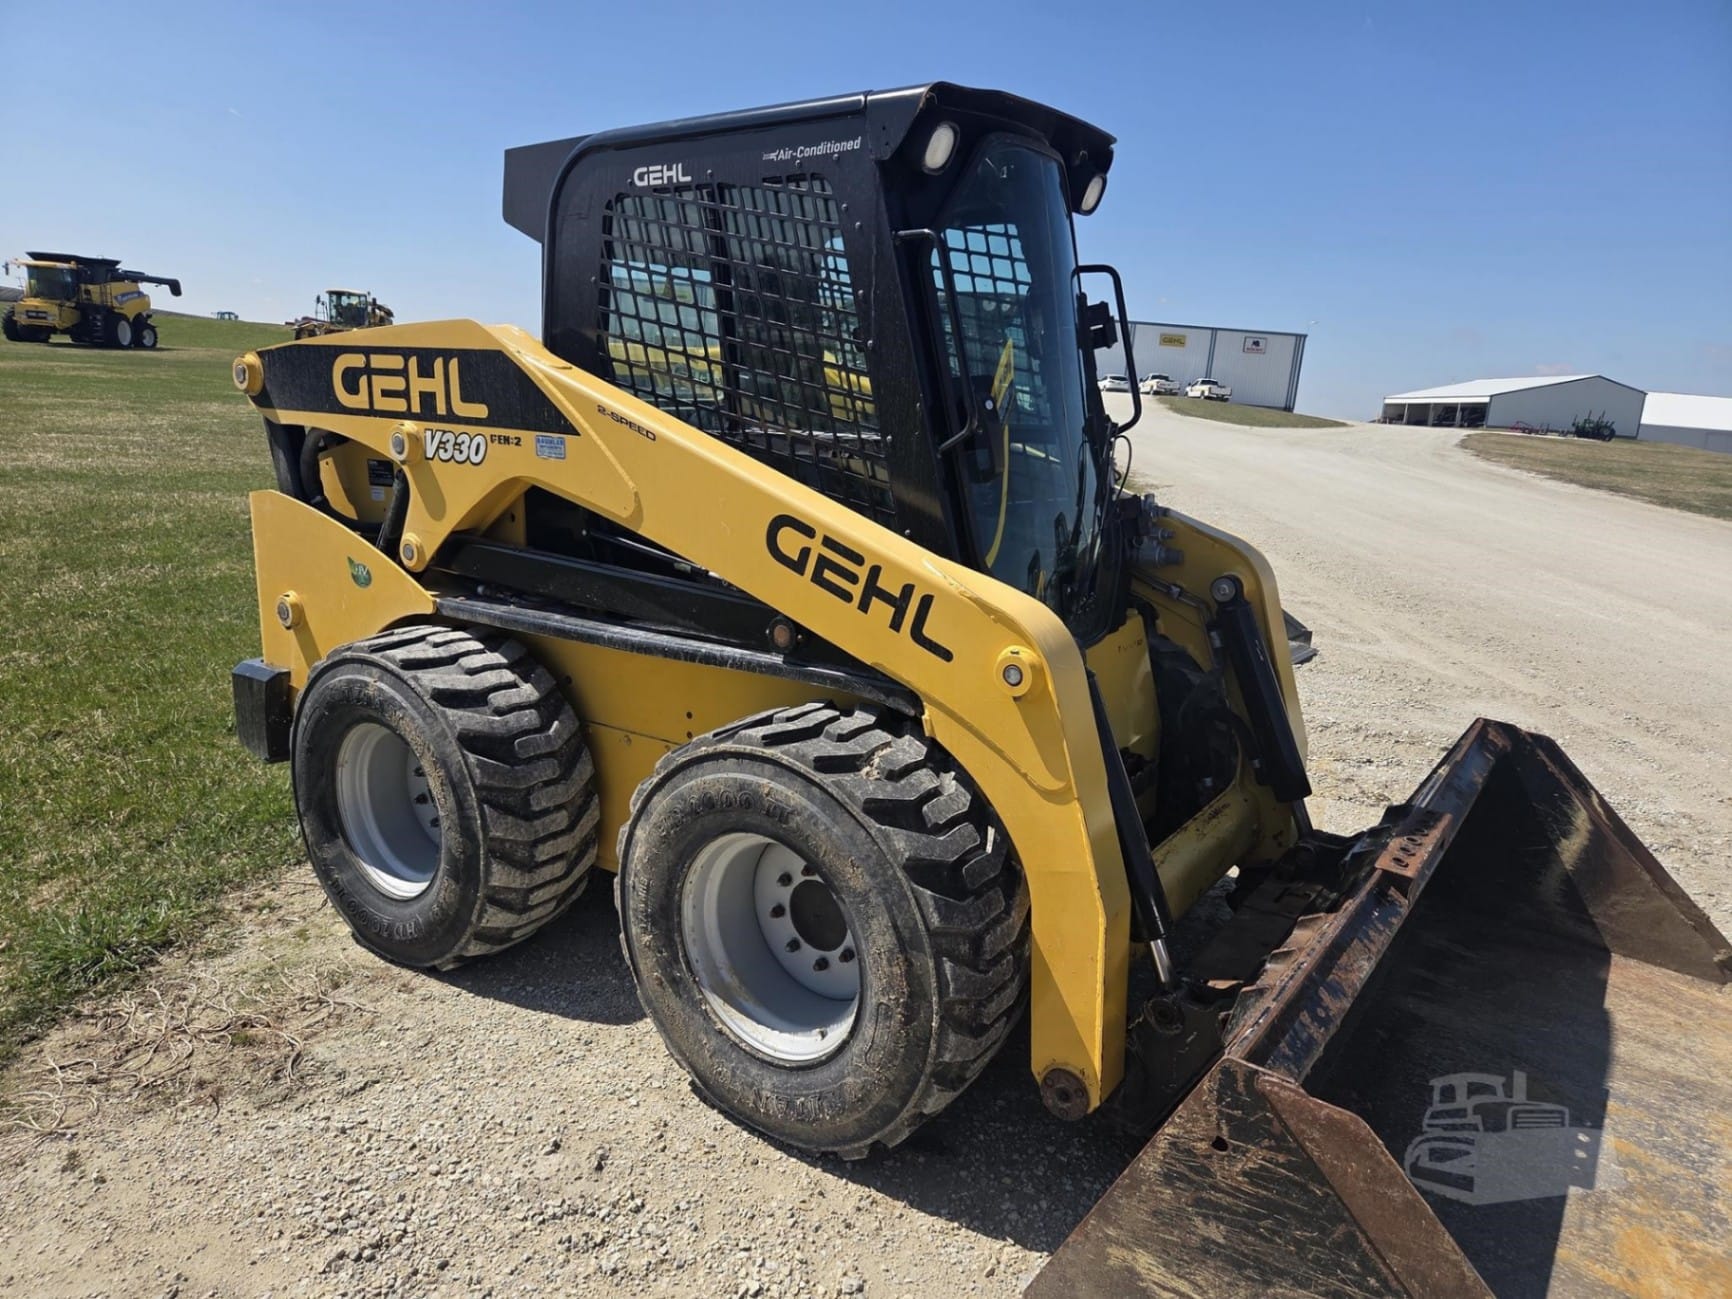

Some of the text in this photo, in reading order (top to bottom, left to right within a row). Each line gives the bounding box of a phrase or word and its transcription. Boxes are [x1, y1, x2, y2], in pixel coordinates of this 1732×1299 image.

[778, 135, 862, 161] Air-Conditioned
[634, 162, 692, 187] GEHL
[332, 353, 489, 419] GEHL
[596, 404, 657, 441] 2-SPEED
[424, 428, 488, 466] V330
[766, 514, 954, 662] GEHL
